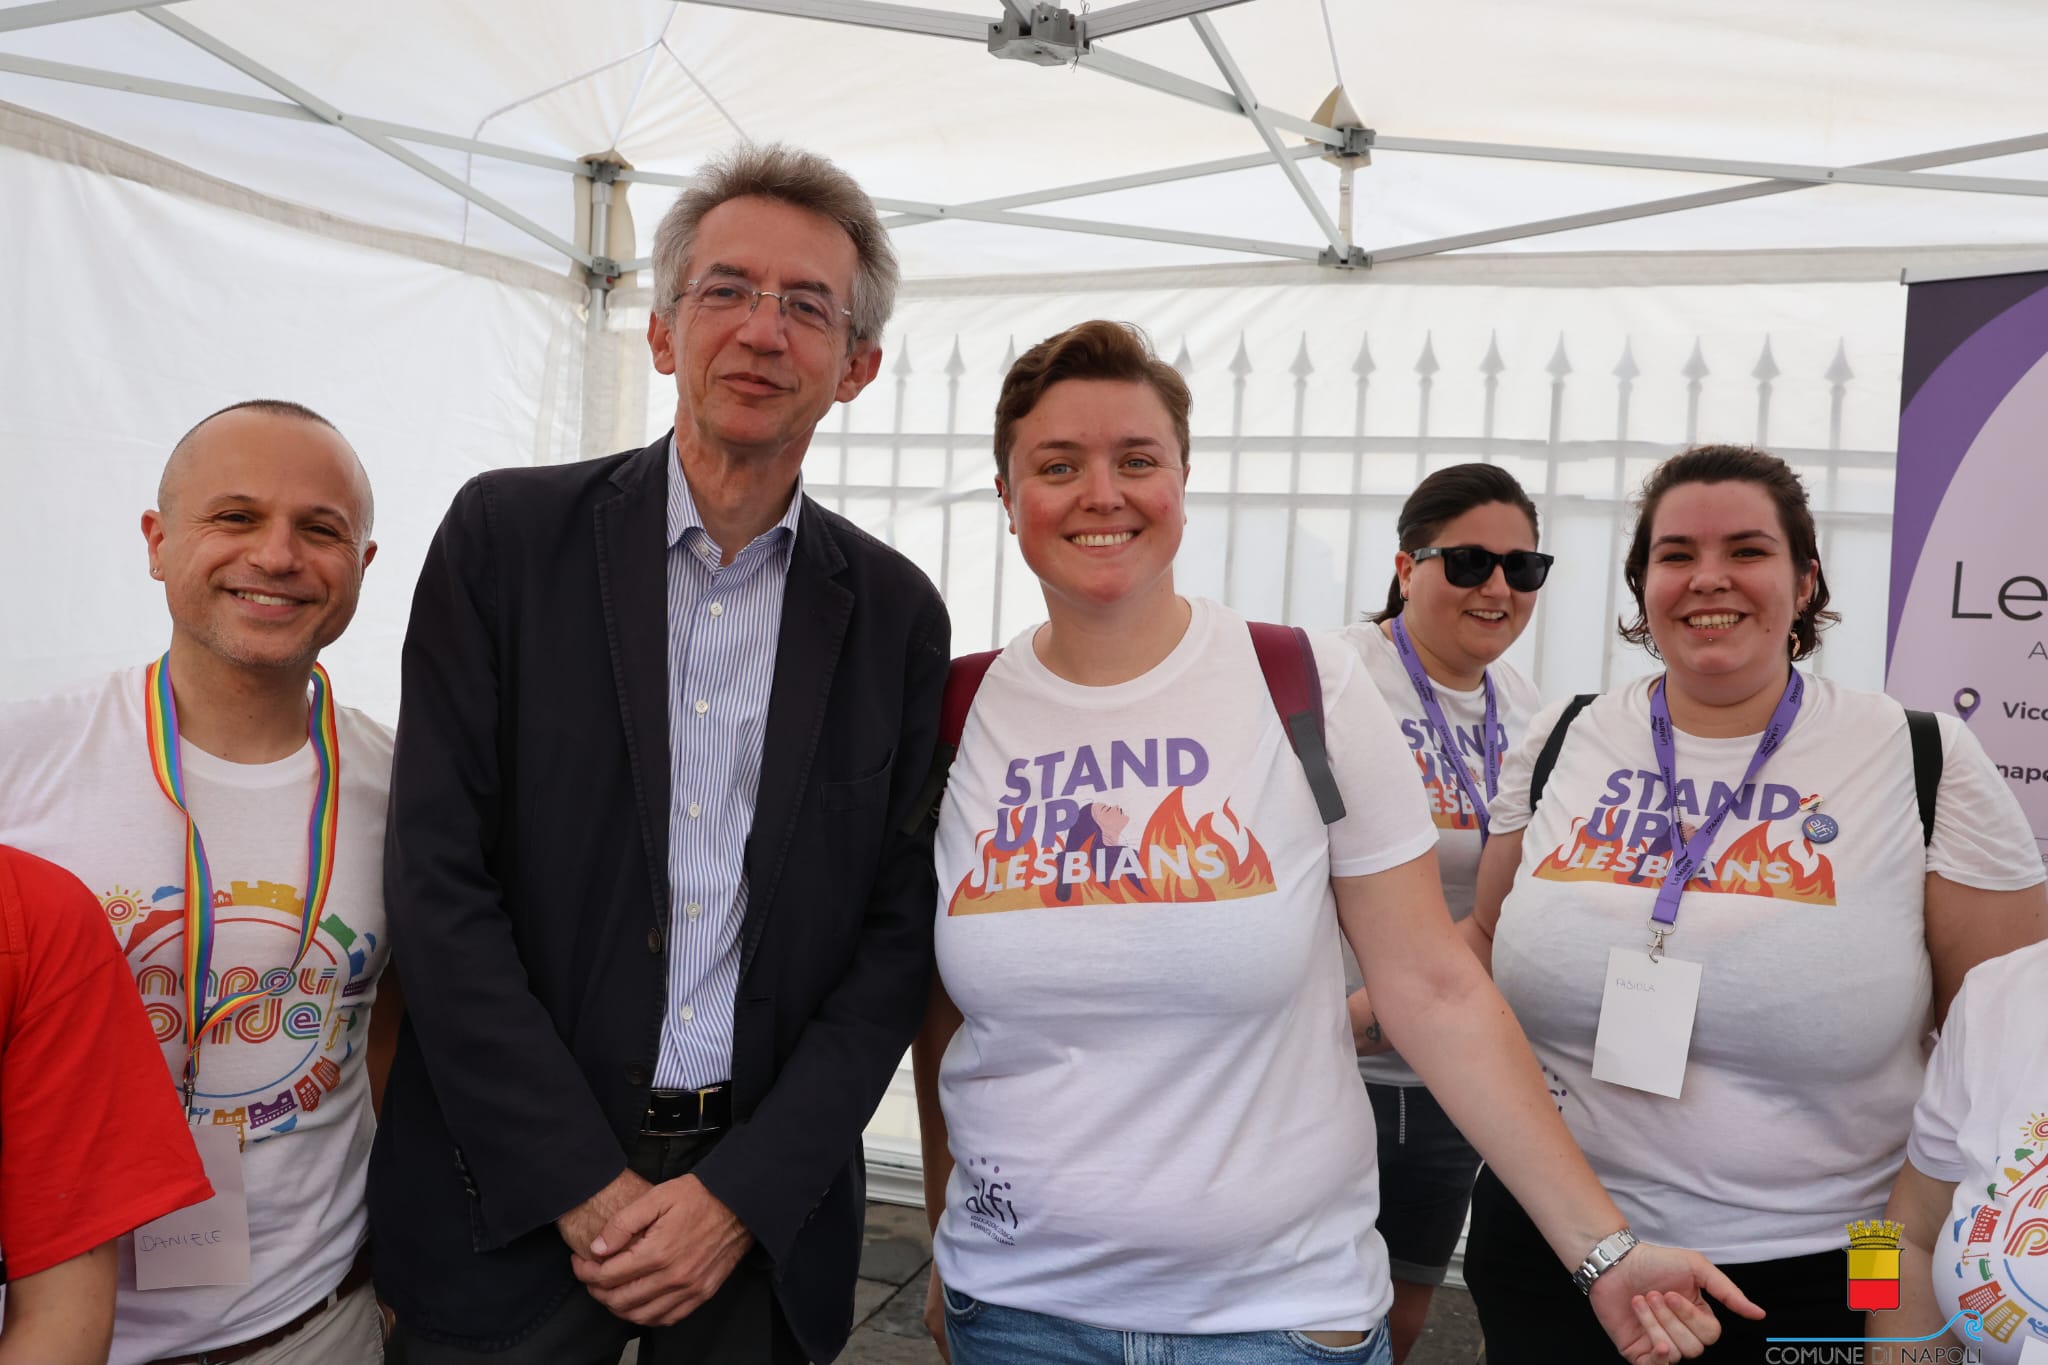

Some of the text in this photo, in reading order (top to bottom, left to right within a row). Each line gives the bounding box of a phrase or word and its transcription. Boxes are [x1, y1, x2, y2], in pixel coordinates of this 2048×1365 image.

[998, 738, 1209, 805] STAND
[1598, 769, 1801, 820] STAND
[993, 798, 1080, 851] UP
[1585, 807, 1671, 849] UP
[984, 845, 1226, 893] LESBIANS
[1567, 842, 1791, 884] LESBANS
